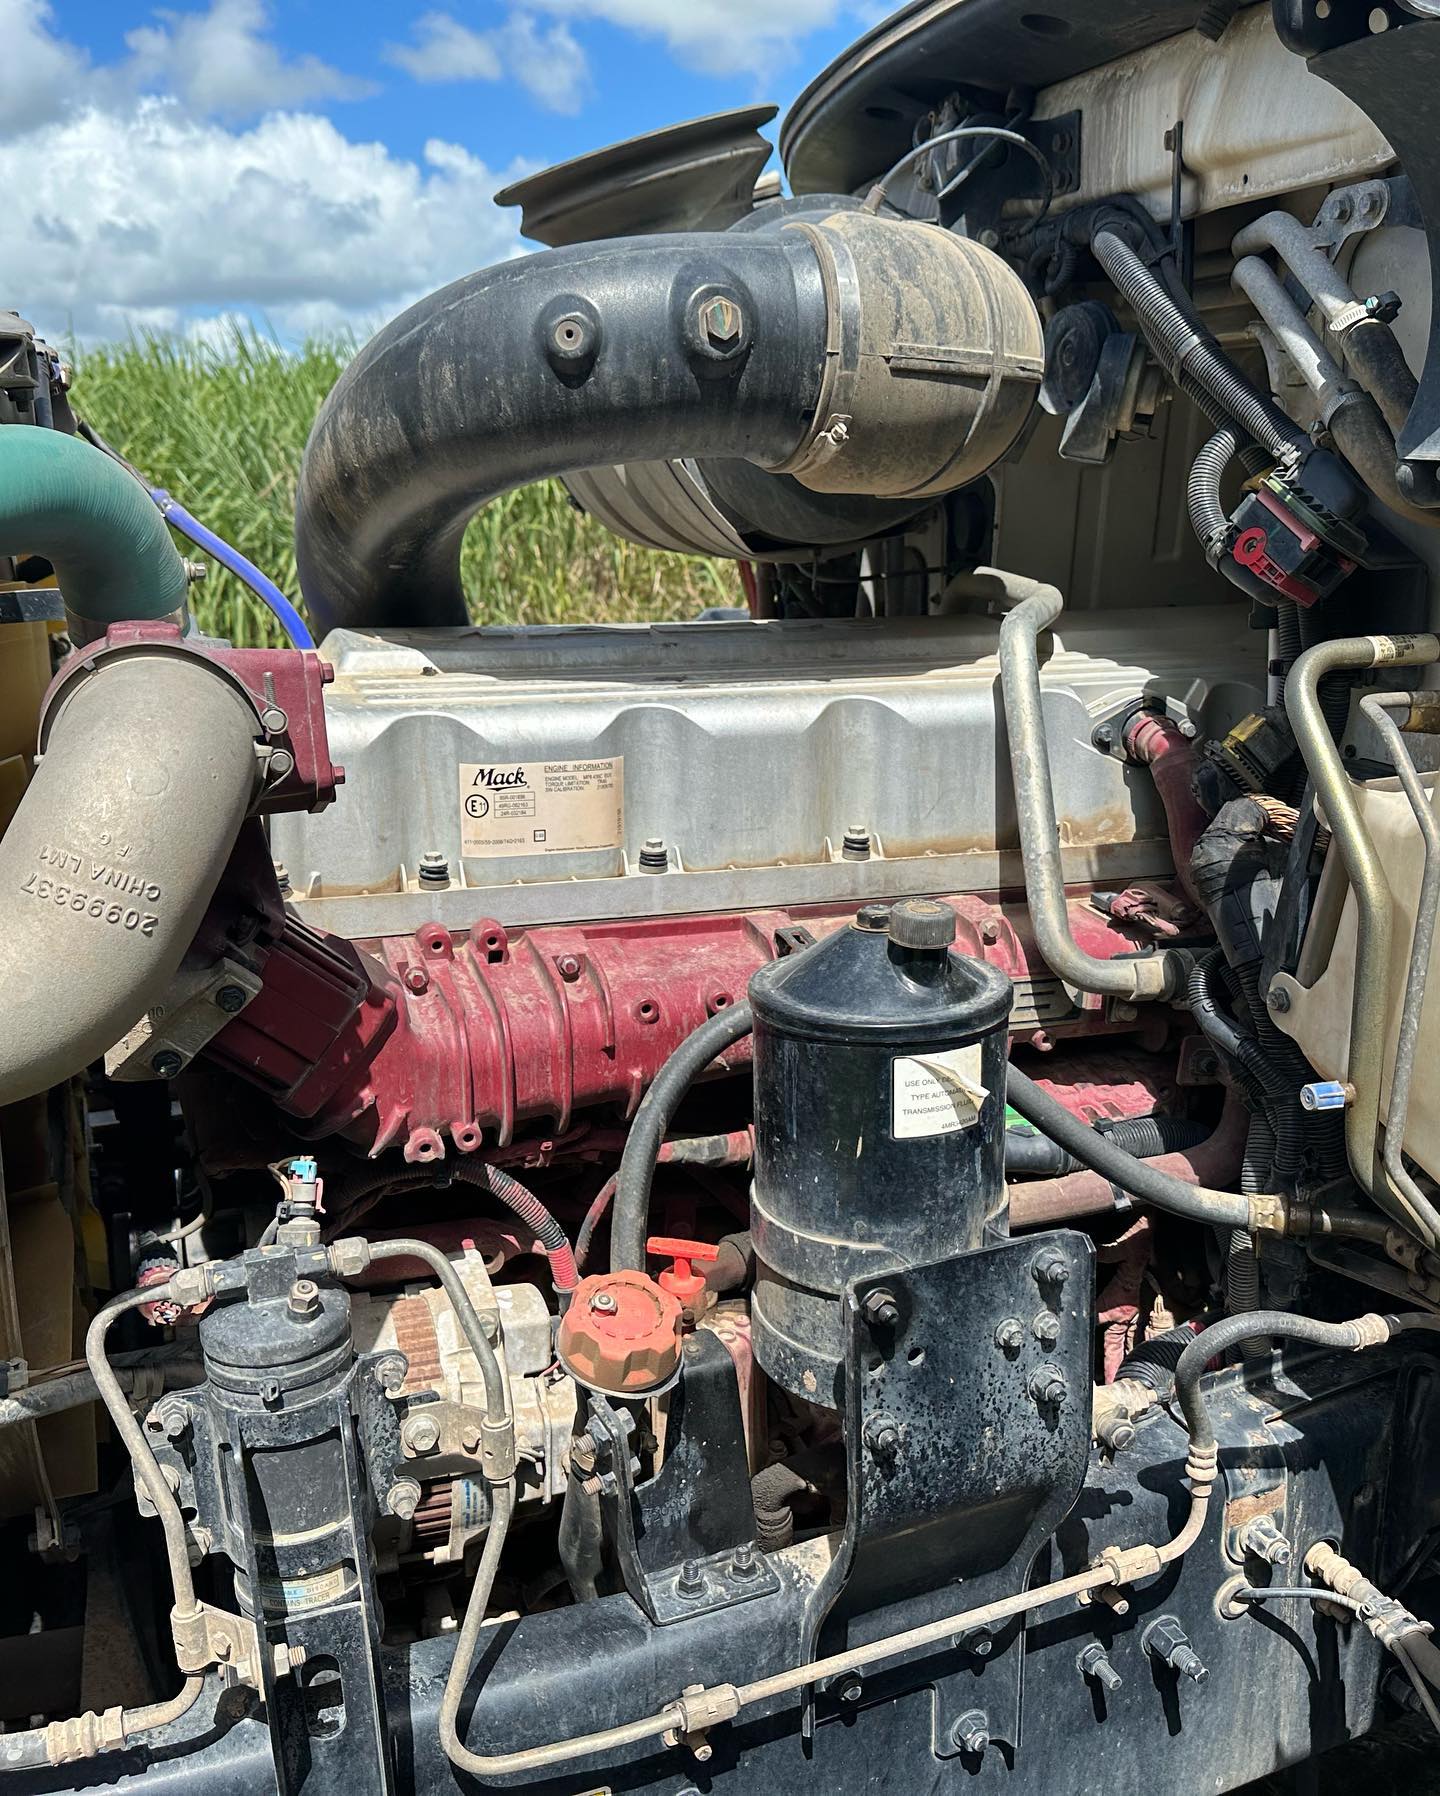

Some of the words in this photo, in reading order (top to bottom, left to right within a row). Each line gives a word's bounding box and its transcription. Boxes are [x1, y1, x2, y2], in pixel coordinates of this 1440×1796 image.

[573, 762, 613, 771] INFORMATION
[472, 766, 527, 791] Mack
[90, 862, 162, 901] CHINA
[20, 872, 160, 938] 20999337
[922, 1078, 939, 1086] ONLY
[911, 1093, 929, 1101] TYPE
[902, 1103, 956, 1115] TRANSMISSION
[305, 1592, 330, 1605] TRACER
